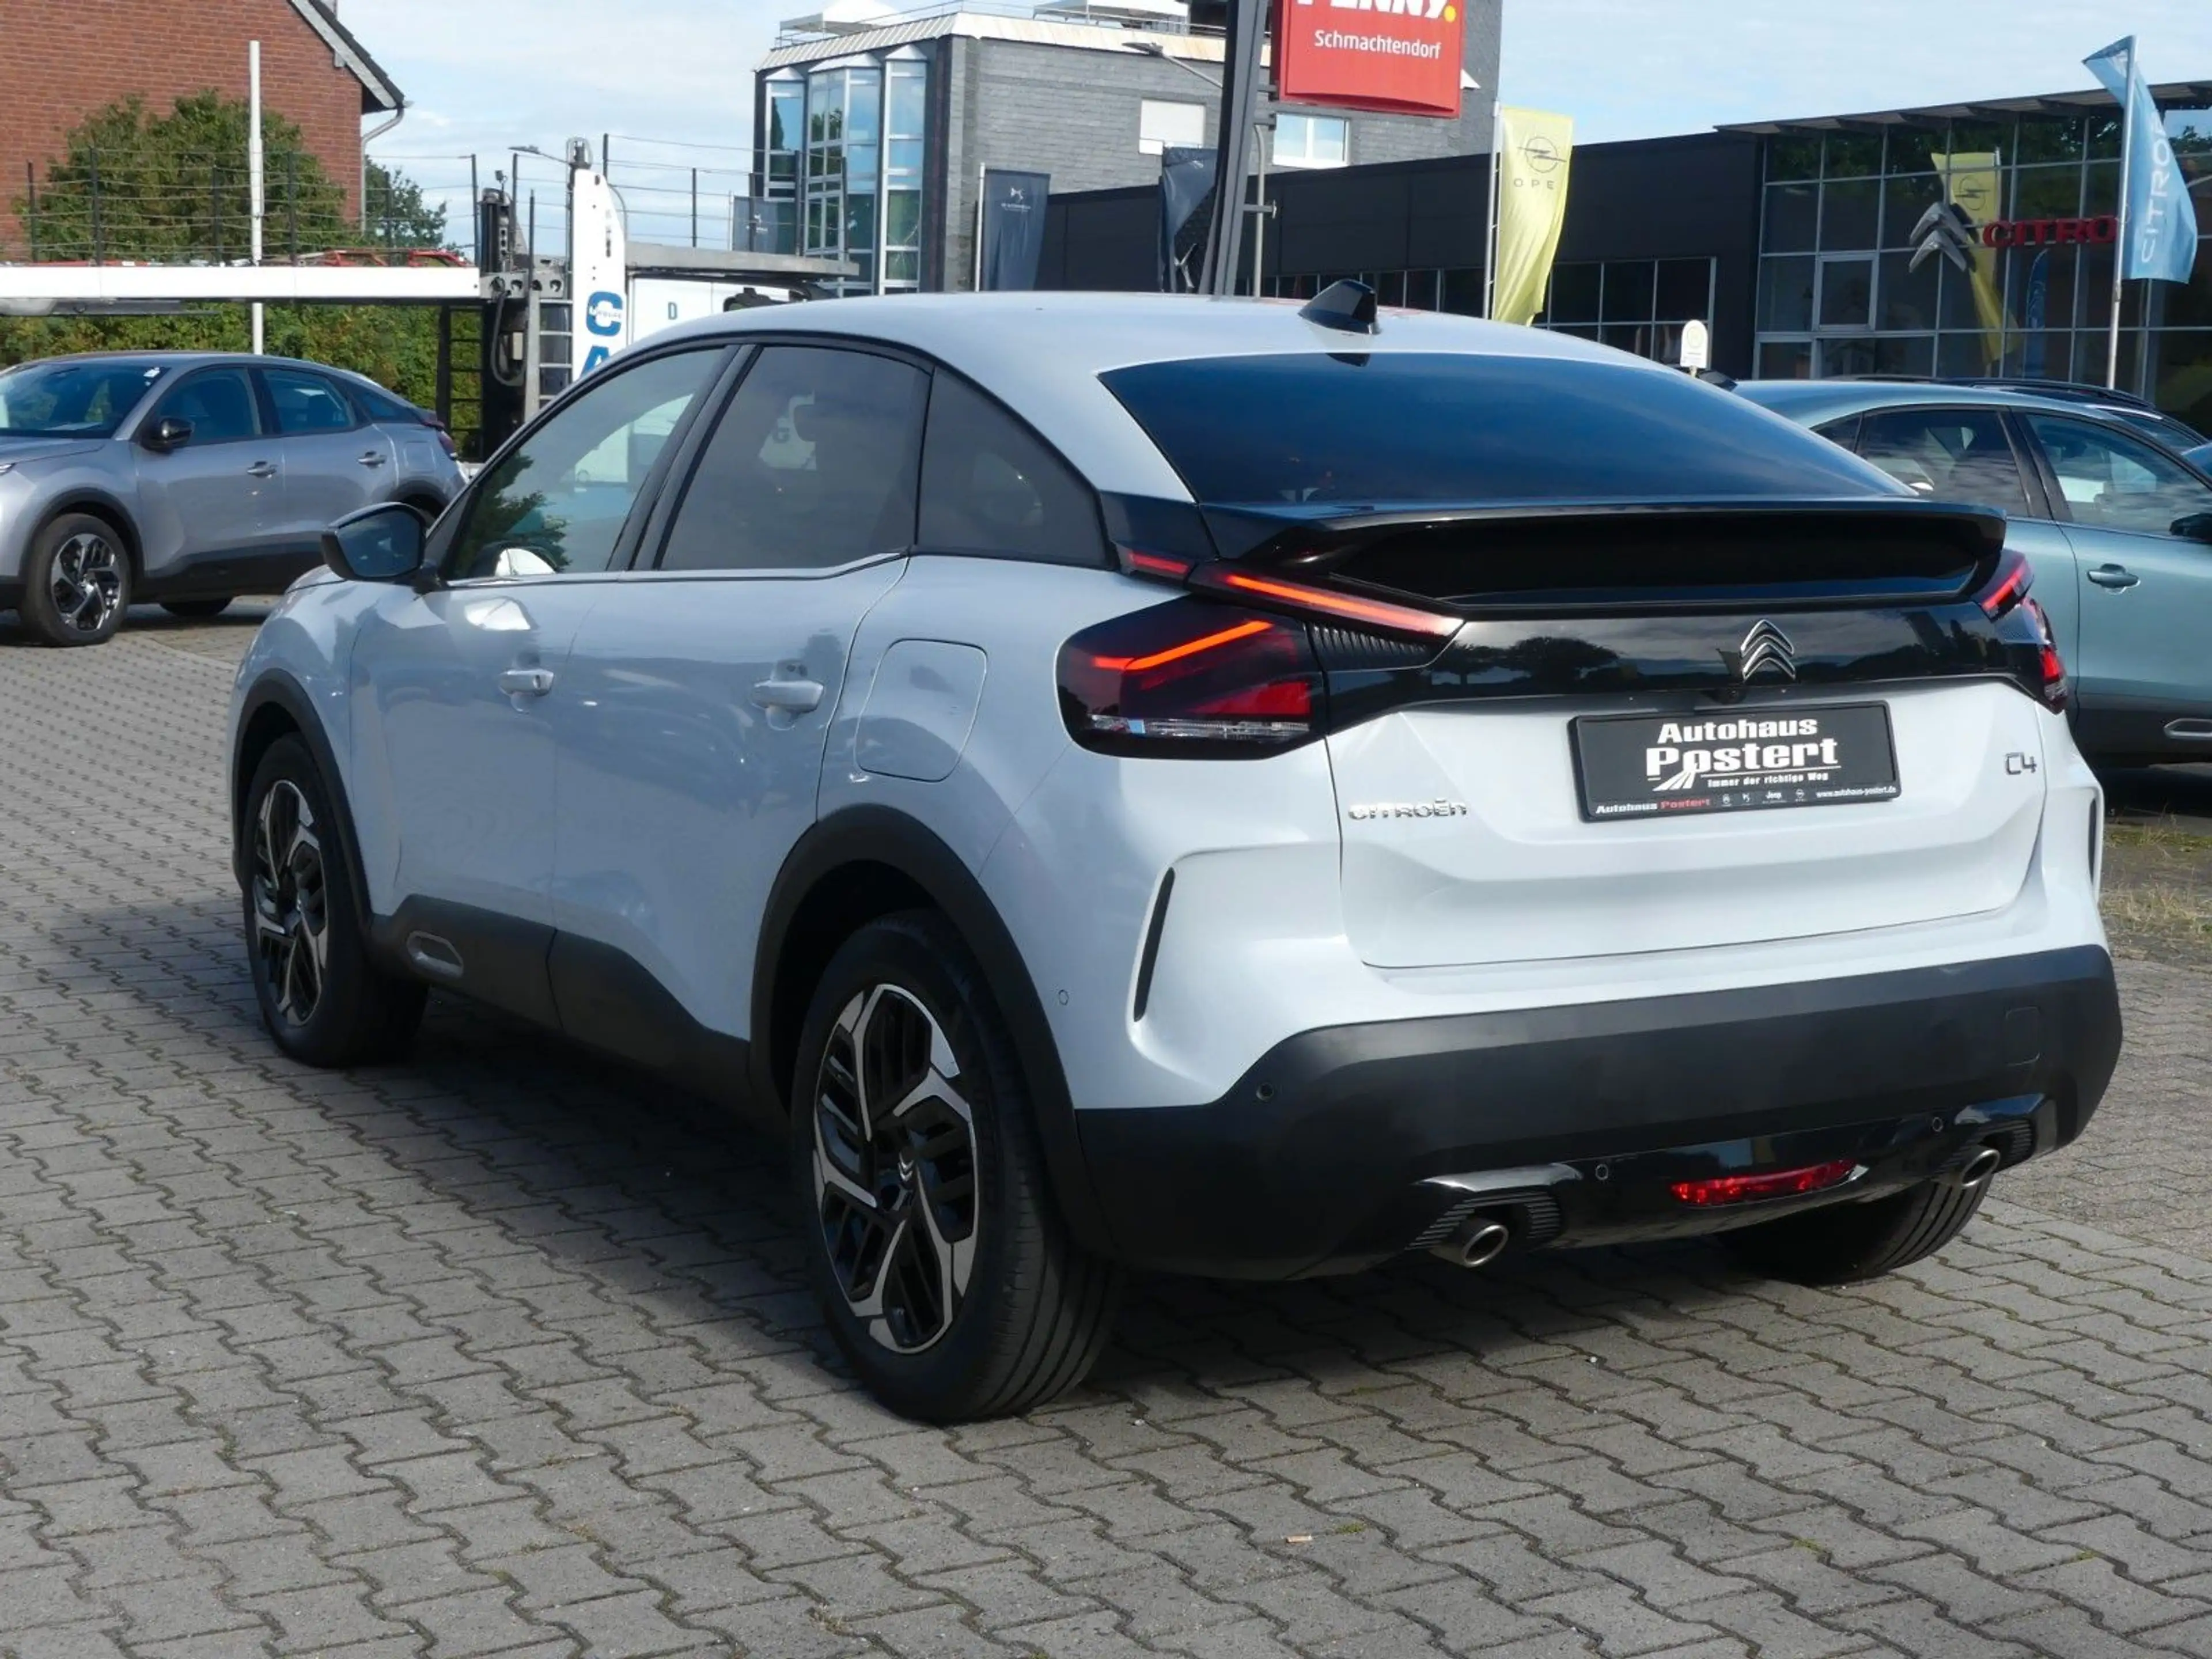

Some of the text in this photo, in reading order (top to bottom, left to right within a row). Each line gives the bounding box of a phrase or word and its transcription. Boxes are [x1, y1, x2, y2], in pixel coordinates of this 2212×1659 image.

[1314, 29, 1441, 59] Schmachtendorf
[1513, 177, 1555, 190] OPE
[1983, 215, 2118, 248] CITRO
[1657, 719, 1818, 744] Autohaus
[1646, 738, 1839, 777] Postert
[2005, 752, 2037, 775] C4
[1743, 777, 1760, 785] der
[1764, 774, 1804, 784] richtige
[1807, 772, 1829, 781] Weg
[1595, 798, 1710, 814] Autohaus Postert
